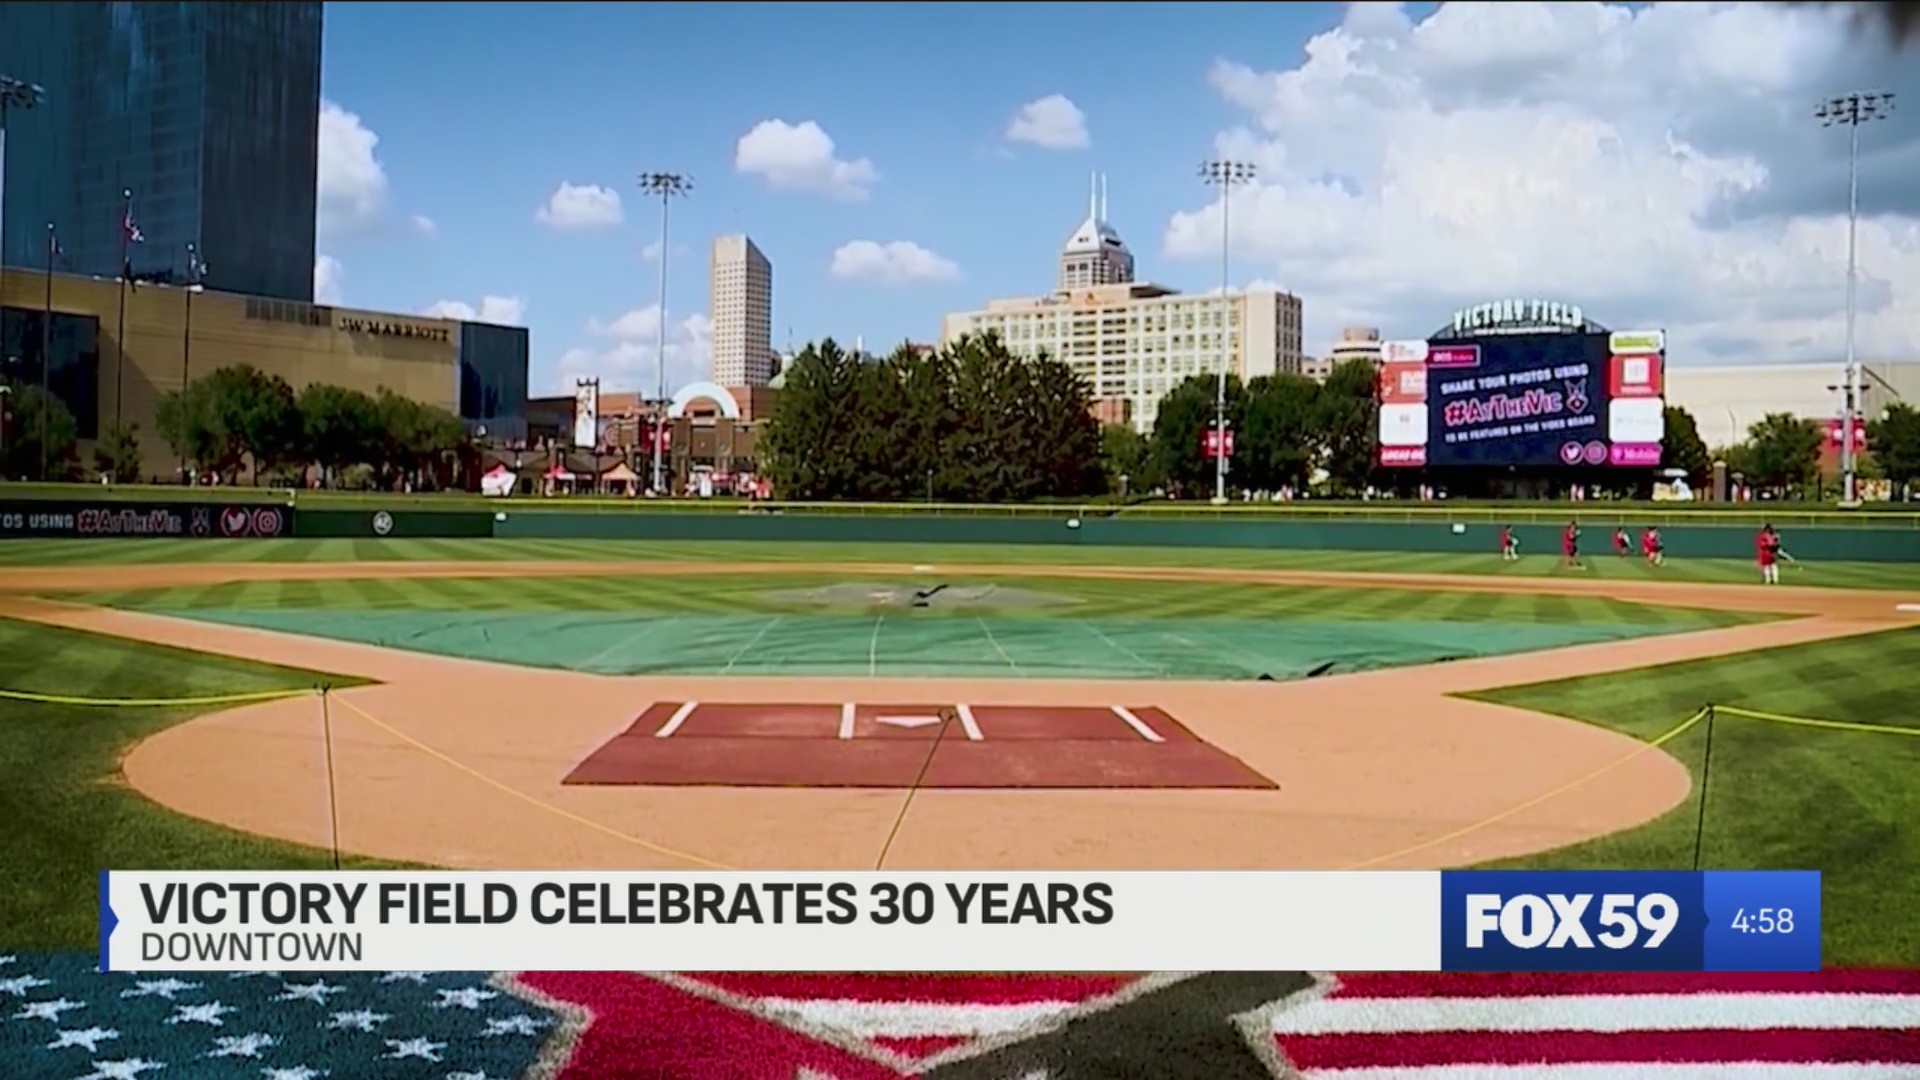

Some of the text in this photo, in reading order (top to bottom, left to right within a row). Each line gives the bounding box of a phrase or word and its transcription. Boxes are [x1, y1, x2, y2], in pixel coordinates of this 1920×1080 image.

[339, 316, 449, 341] JW MARRIOTT
[1454, 299, 1582, 332] VICTORY FIELD
[1441, 379, 1475, 395] SHARE
[1478, 375, 1506, 390] YOUR
[1509, 368, 1551, 385] PHOTOS
[1554, 363, 1589, 378] USING
[29, 514, 74, 529] USING
